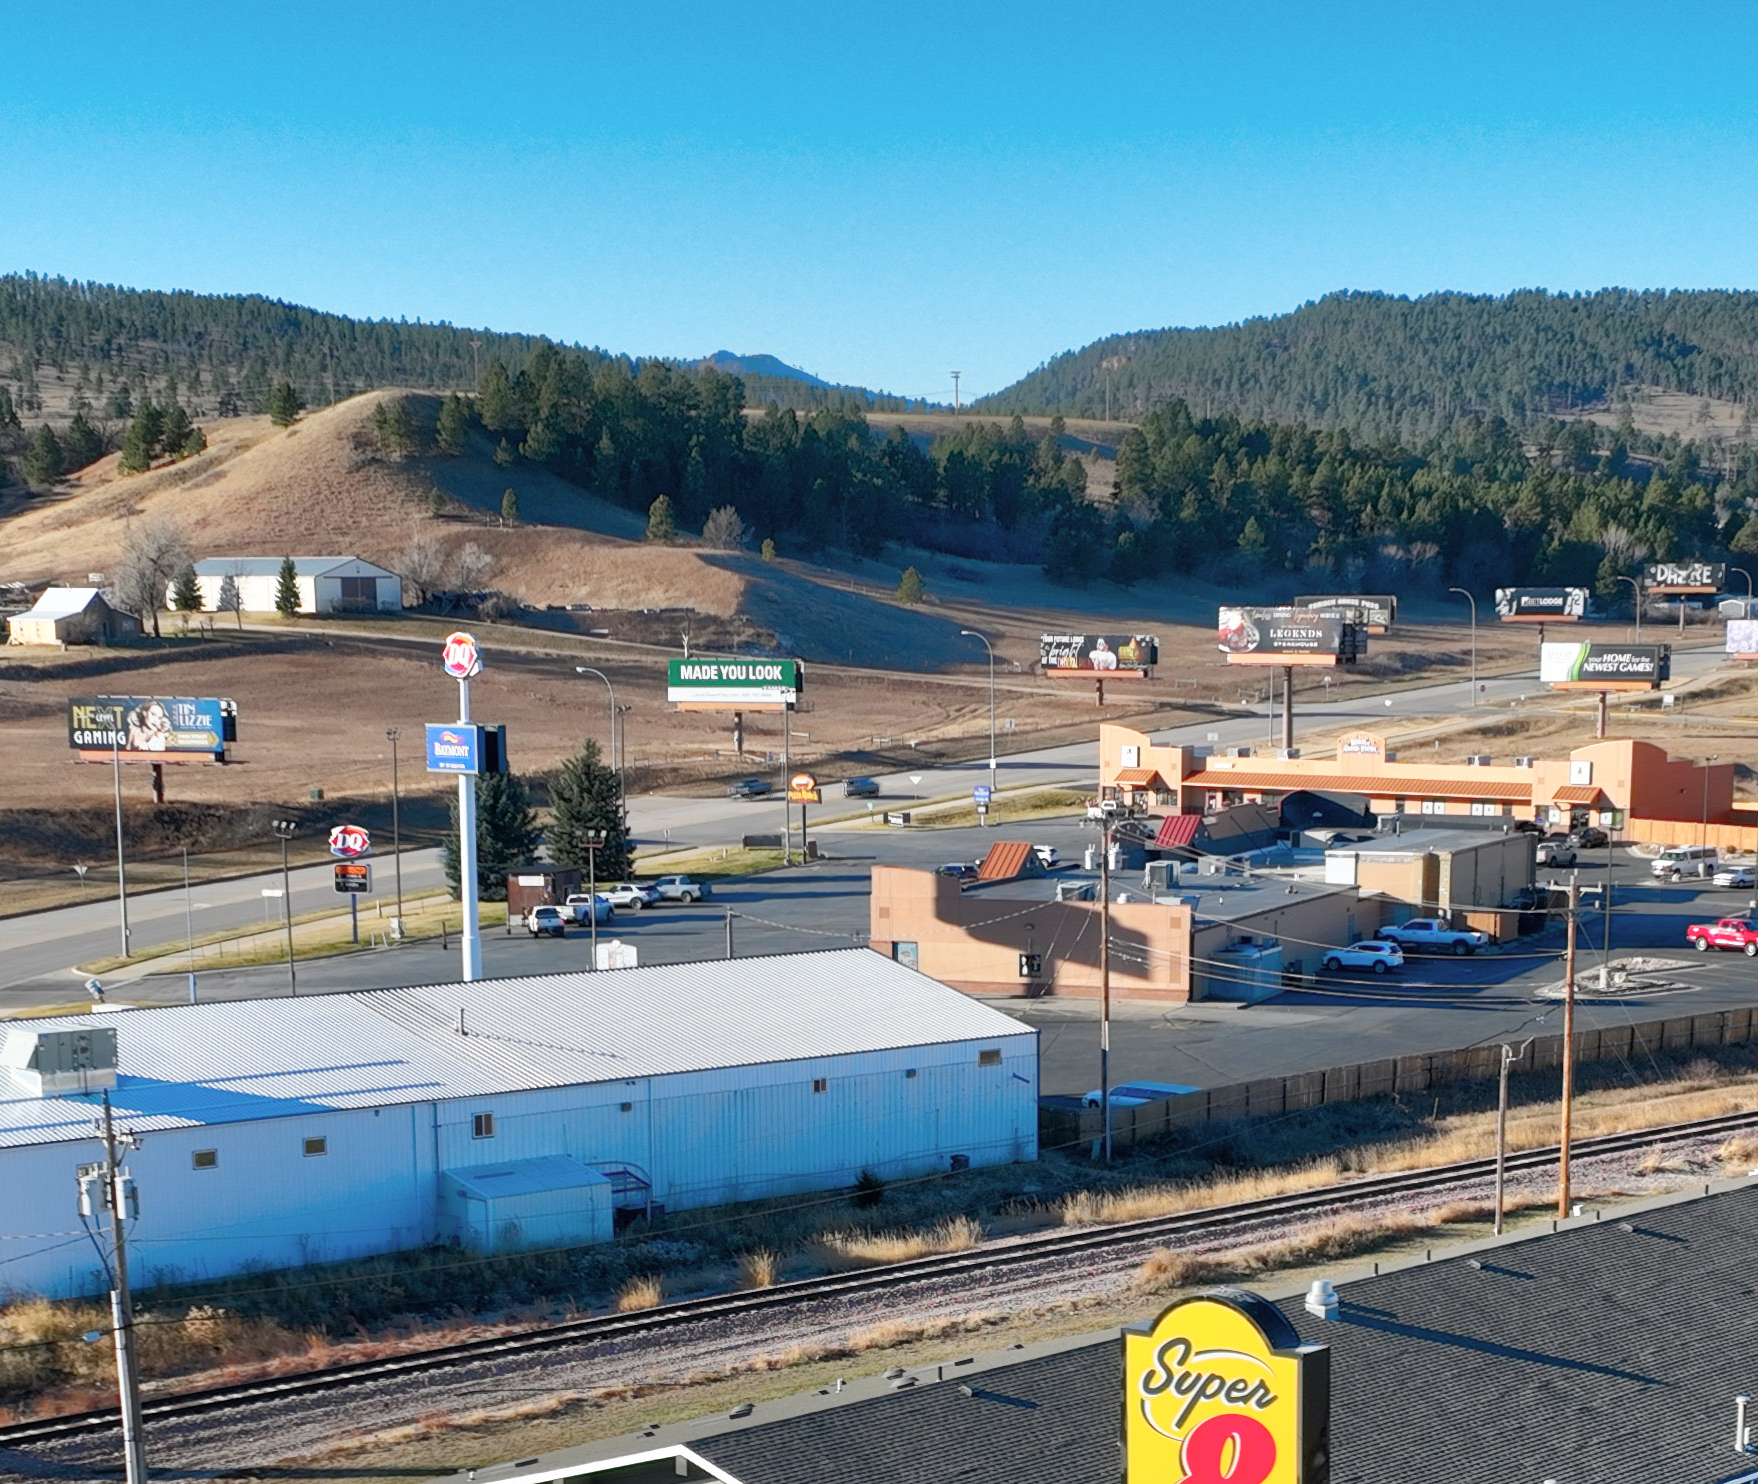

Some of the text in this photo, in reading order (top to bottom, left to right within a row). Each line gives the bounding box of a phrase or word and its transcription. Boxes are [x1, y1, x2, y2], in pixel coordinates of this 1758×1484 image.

[1269, 628, 1323, 638] LEGENDS
[448, 643, 471, 666] DQ
[1602, 654, 1632, 663] HOME
[680, 665, 782, 680] MADE YOU LOOK
[1583, 663, 1654, 672] NEWEST GAMES!
[178, 703, 196, 715] TIN
[72, 706, 124, 729] NEXT
[179, 715, 212, 727] LIZZIE
[73, 731, 126, 745] GAMING
[338, 833, 363, 852] DQ
[1141, 1336, 1279, 1431] Super
